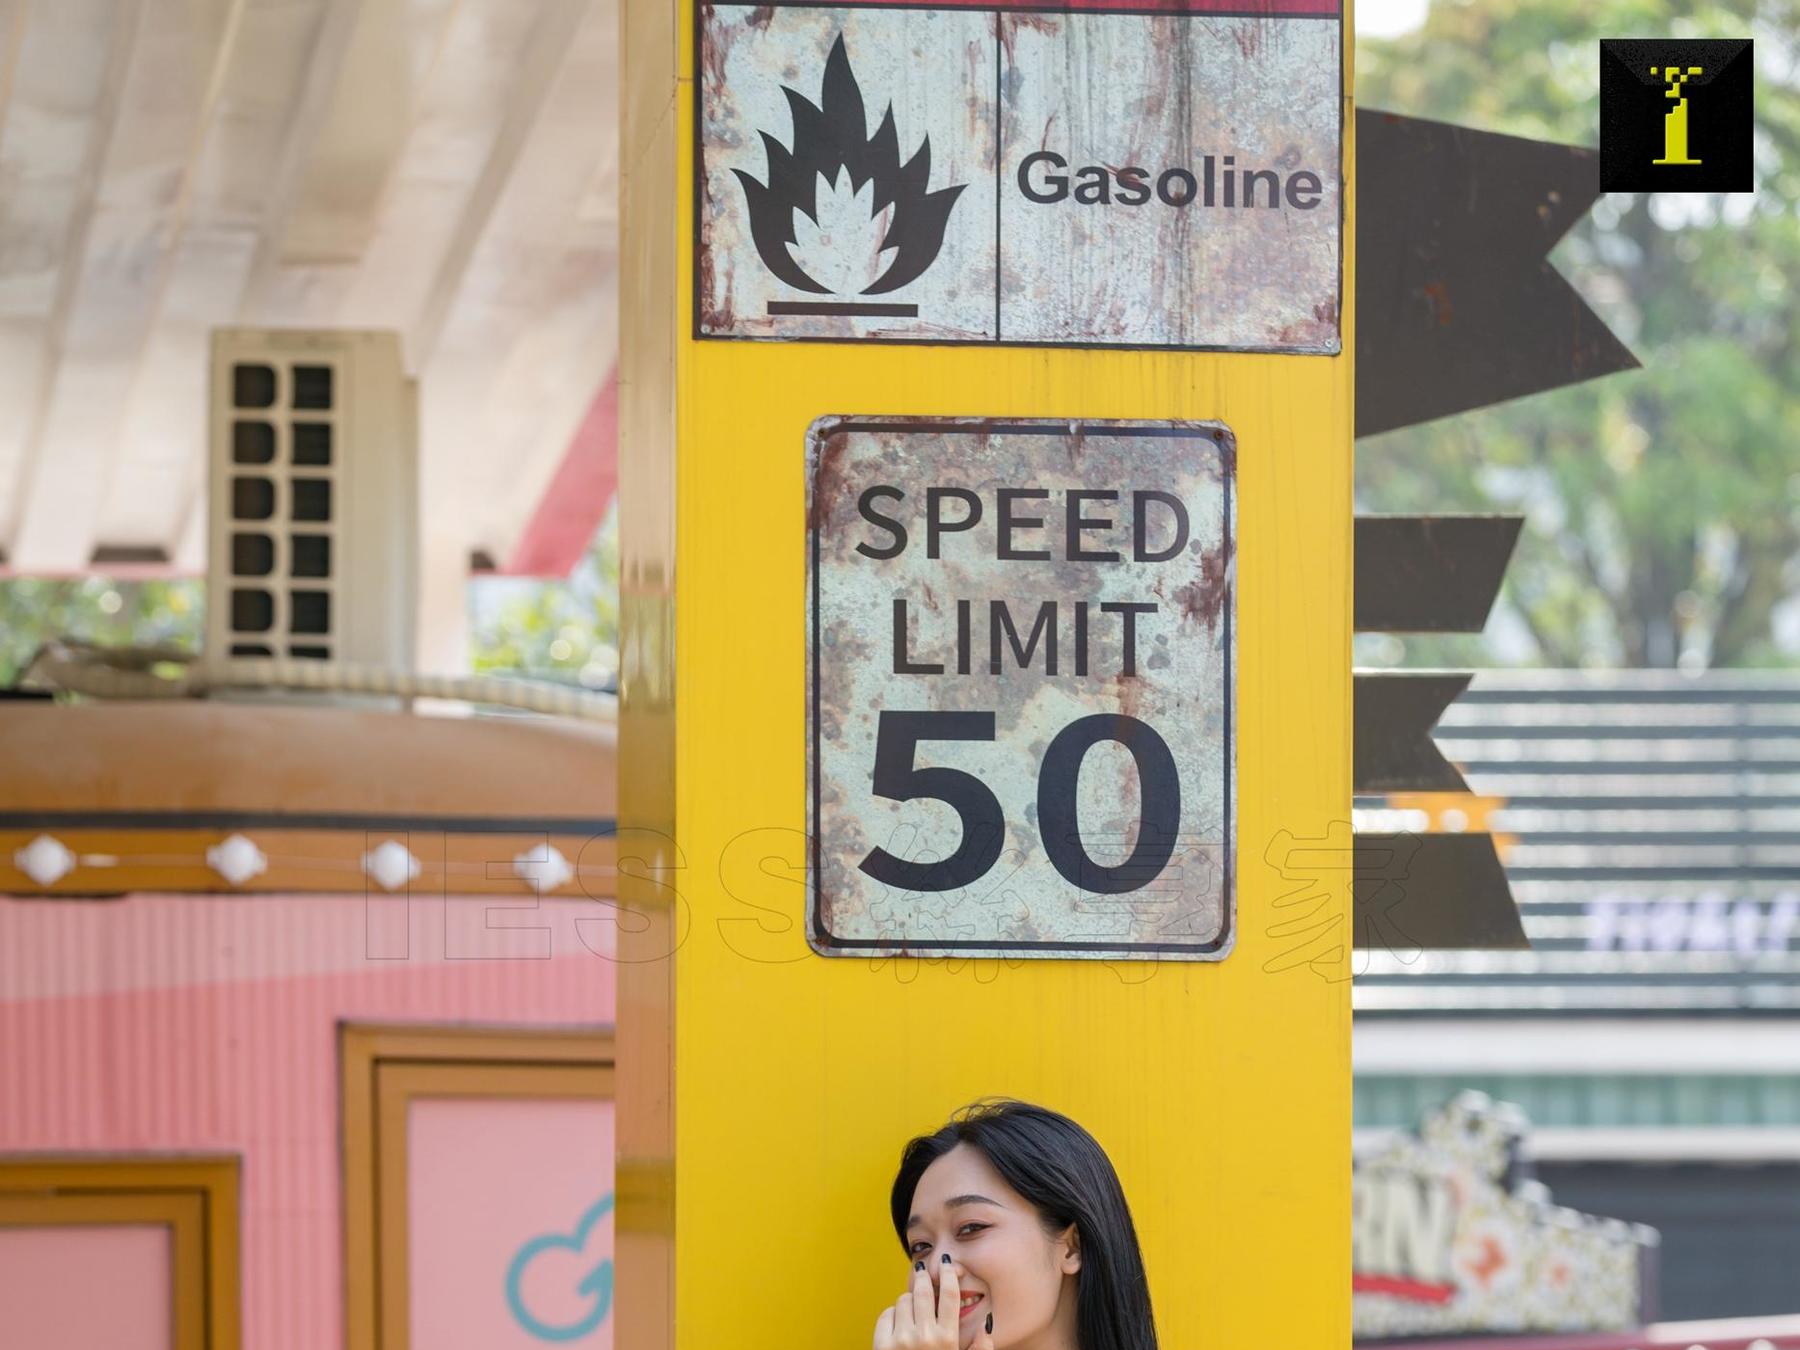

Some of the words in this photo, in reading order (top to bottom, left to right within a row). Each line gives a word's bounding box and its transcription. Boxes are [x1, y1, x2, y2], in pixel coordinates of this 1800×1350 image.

[1016, 150, 1323, 211] Gasoline
[854, 485, 1190, 563] SPEED
[892, 599, 1159, 678] LIMIT
[857, 709, 1182, 895] 50
